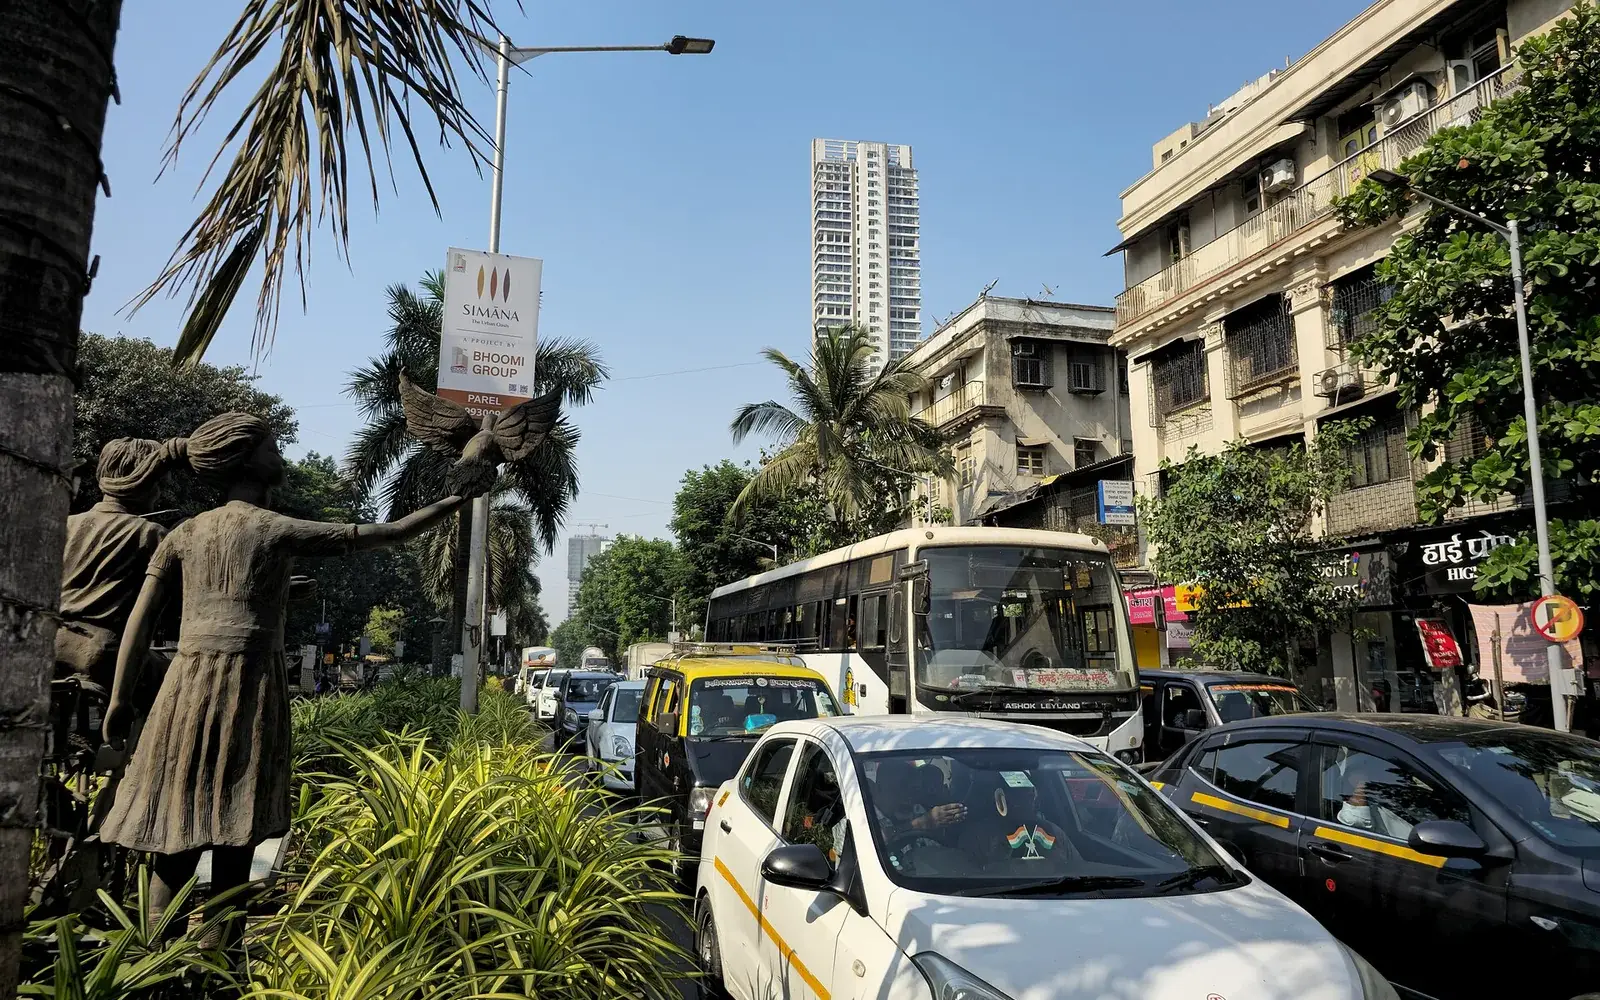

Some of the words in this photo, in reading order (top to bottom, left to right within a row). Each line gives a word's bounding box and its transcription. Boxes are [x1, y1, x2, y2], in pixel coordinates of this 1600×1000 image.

[462, 303, 519, 322] SIMĀNA
[471, 338, 503, 347] PROJECT
[473, 350, 525, 367] BHOOMI
[472, 364, 518, 378] GROUP
[467, 394, 502, 406] PAREL
[1420, 533, 1463, 565] हाई
